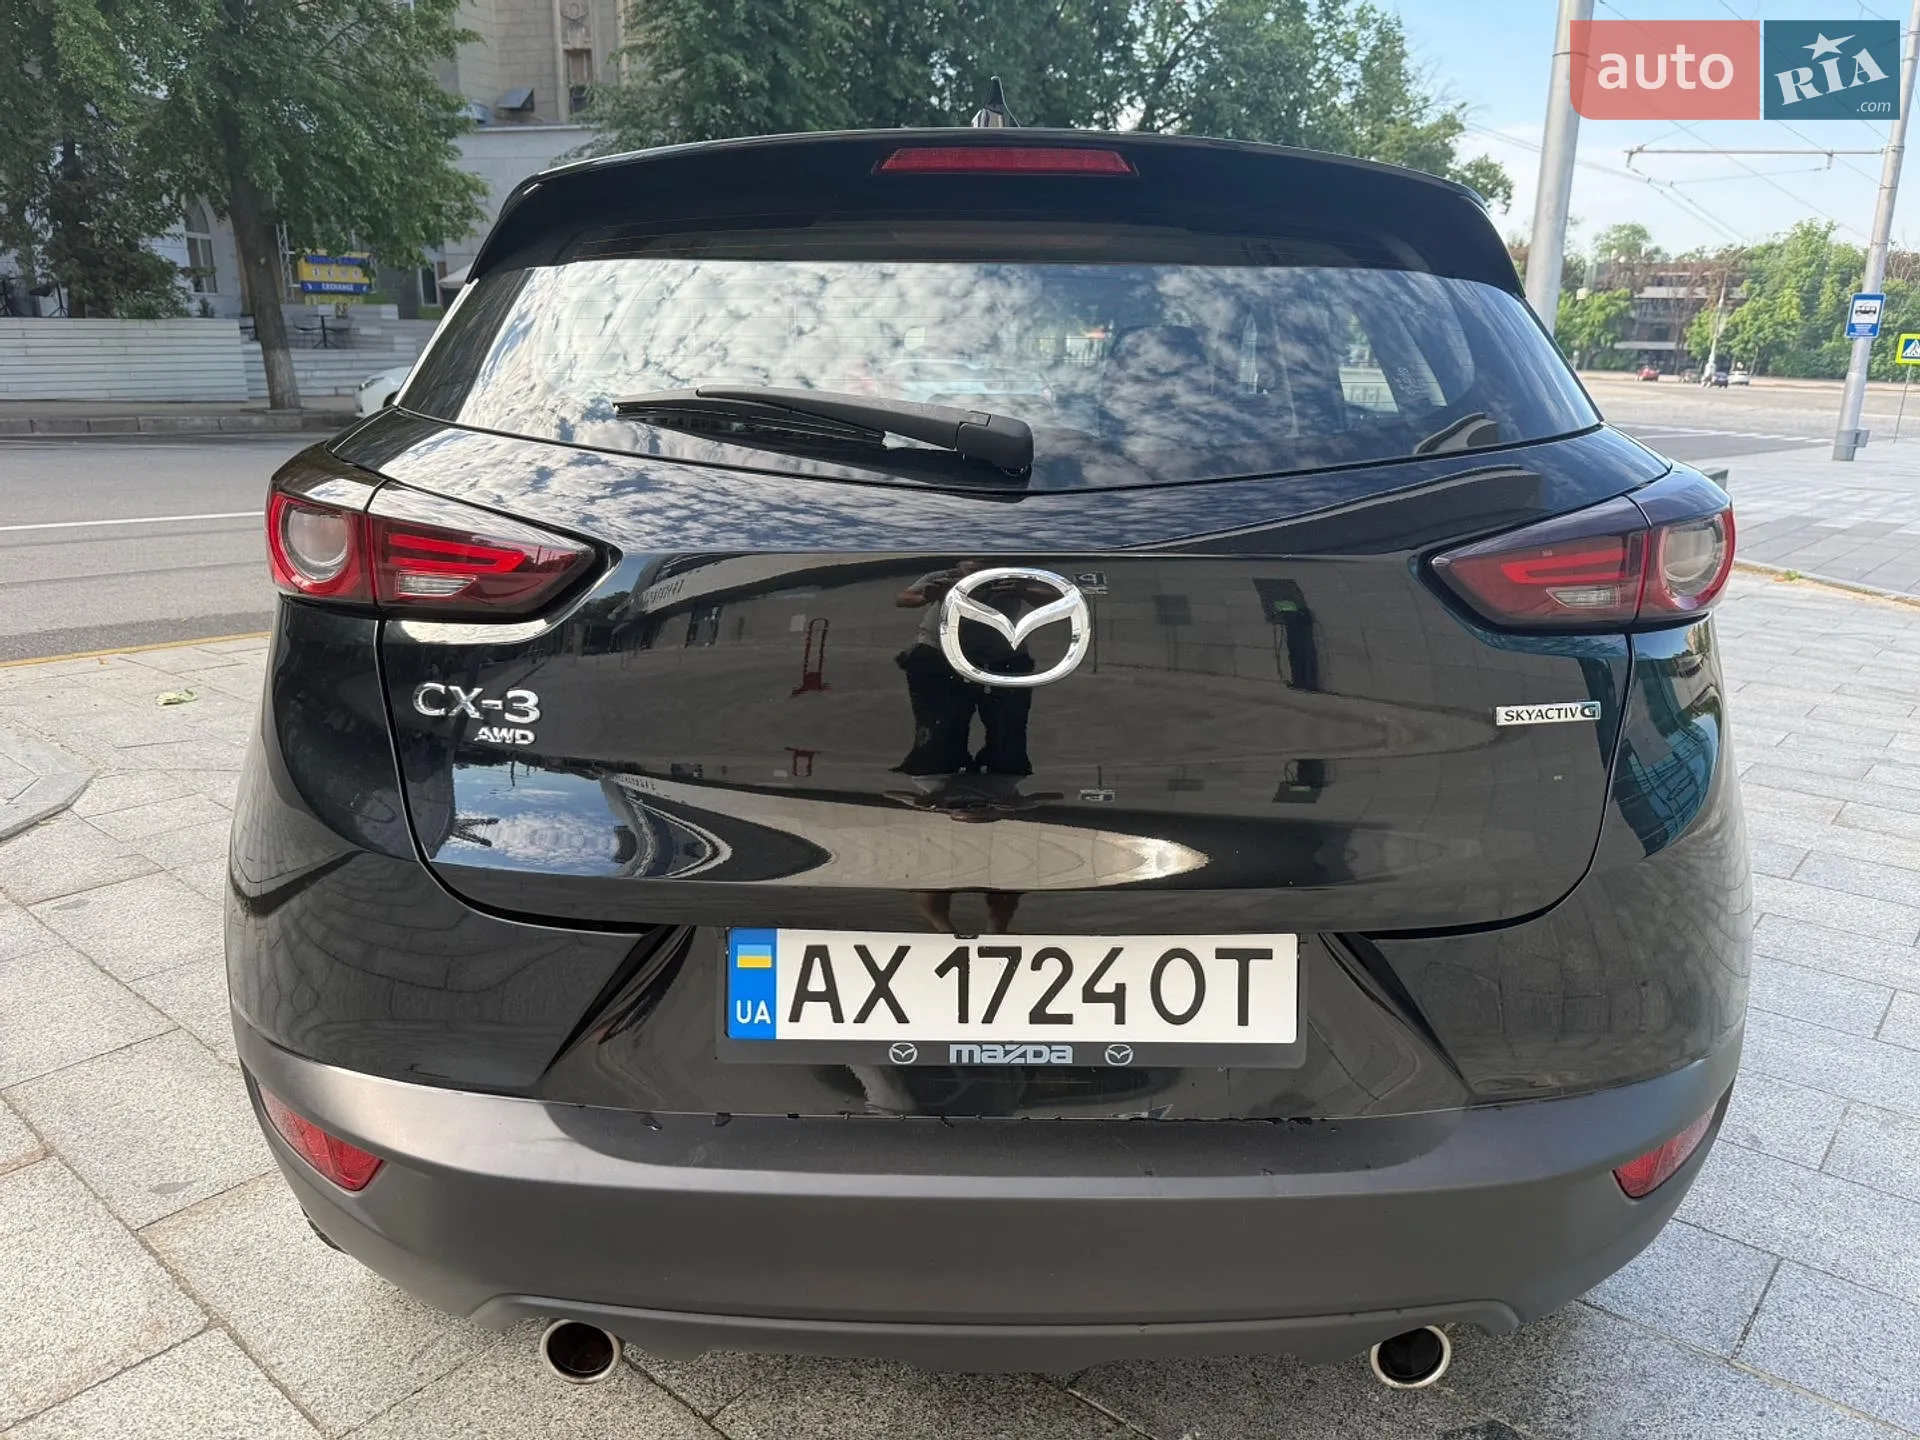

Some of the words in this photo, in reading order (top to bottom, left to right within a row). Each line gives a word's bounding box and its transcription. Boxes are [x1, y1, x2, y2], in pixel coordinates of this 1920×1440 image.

[412, 682, 541, 724] CX-3
[474, 727, 536, 745] AWD
[788, 944, 911, 1023] AX
[934, 946, 1127, 1025] 1724
[1149, 947, 1274, 1027] OT
[736, 1001, 771, 1024] UA
